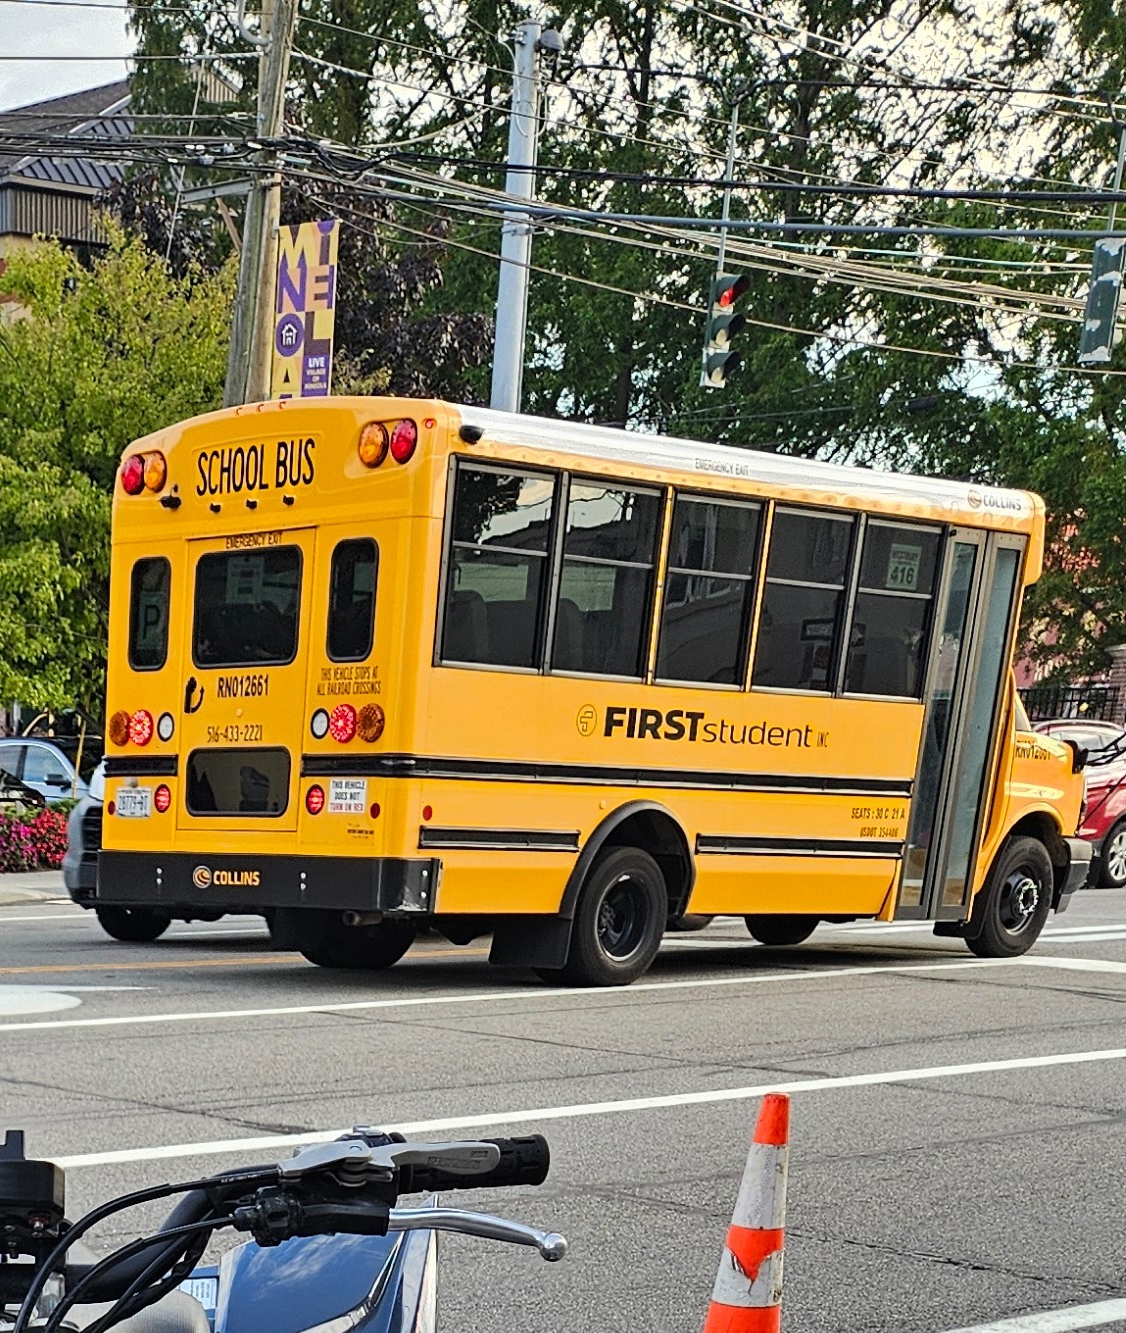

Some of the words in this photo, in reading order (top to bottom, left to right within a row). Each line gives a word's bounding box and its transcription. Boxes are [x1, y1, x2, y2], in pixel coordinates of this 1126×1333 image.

[308, 356, 325, 368] LIVE
[196, 444, 269, 496] SCHOOL
[275, 438, 315, 488] BUS
[694, 458, 733, 475] EMERGENCY
[735, 463, 750, 477] EXIT
[983, 494, 1022, 511] COLLINS
[225, 533, 266, 549] EMERGENCY
[267, 530, 283, 545] EXIT
[890, 566, 915, 585] 416
[142, 604, 161, 640] P
[320, 668, 332, 681] THIS
[334, 667, 354, 680] VEHICLE
[355, 666, 371, 679] STOPS
[217, 673, 269, 698] RN012661
[316, 683, 326, 696] ALL
[327, 682, 352, 695] RAILROAD
[353, 681, 381, 694] CROSSINGS
[207, 724, 263, 743] 516-433-2221
[332, 781, 343, 789] THIS
[344, 781, 365, 789] VEHICLE
[335, 792, 348, 800] DOES
[349, 792, 361, 800] NOT
[330, 803, 343, 811] TURN
[344, 803, 352, 811] ON
[354, 803, 363, 811] RED
[213, 870, 261, 886] COLLINS
